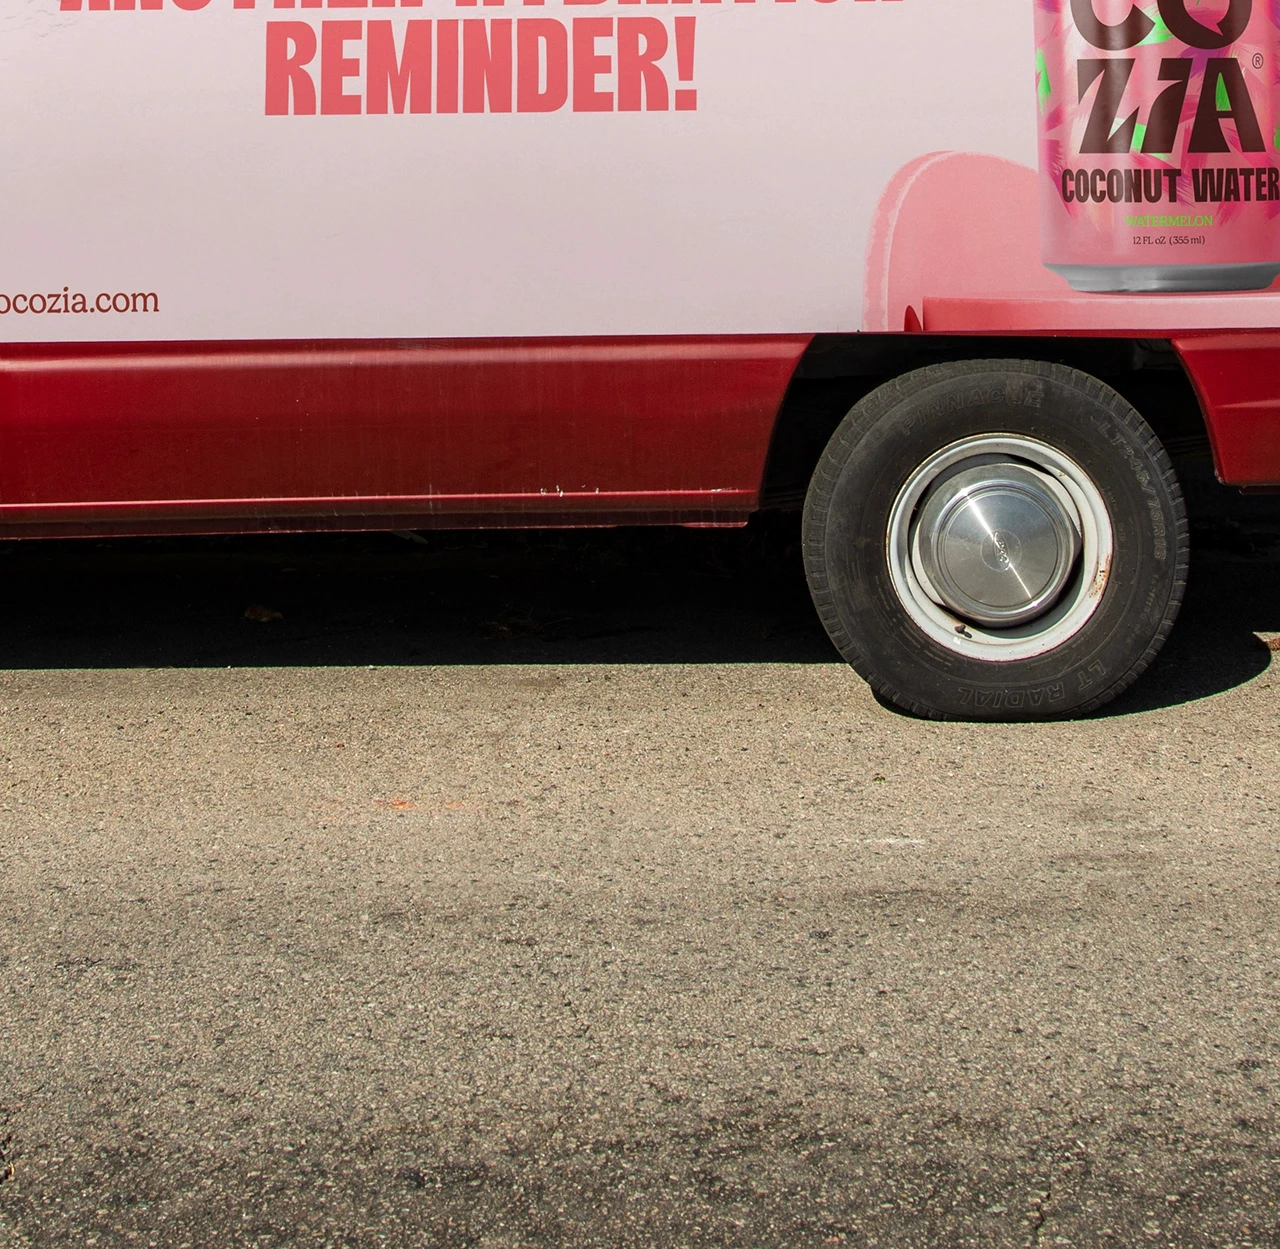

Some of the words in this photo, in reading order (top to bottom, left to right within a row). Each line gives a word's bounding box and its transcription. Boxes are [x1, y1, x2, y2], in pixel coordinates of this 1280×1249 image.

[264, 15, 698, 116] REMINDER!
[1061, 168, 1182, 204] COCONUT
[1192, 167, 1280, 203] WATER
[1124, 215, 1214, 227] WATERMELON
[1132, 236, 1142, 245] 12
[1143, 236, 1154, 245] FL
[1169, 235, 1190, 246] (355
[900, 387, 1045, 437] PINNACLE
[957, 681, 1066, 709] RADIAL
